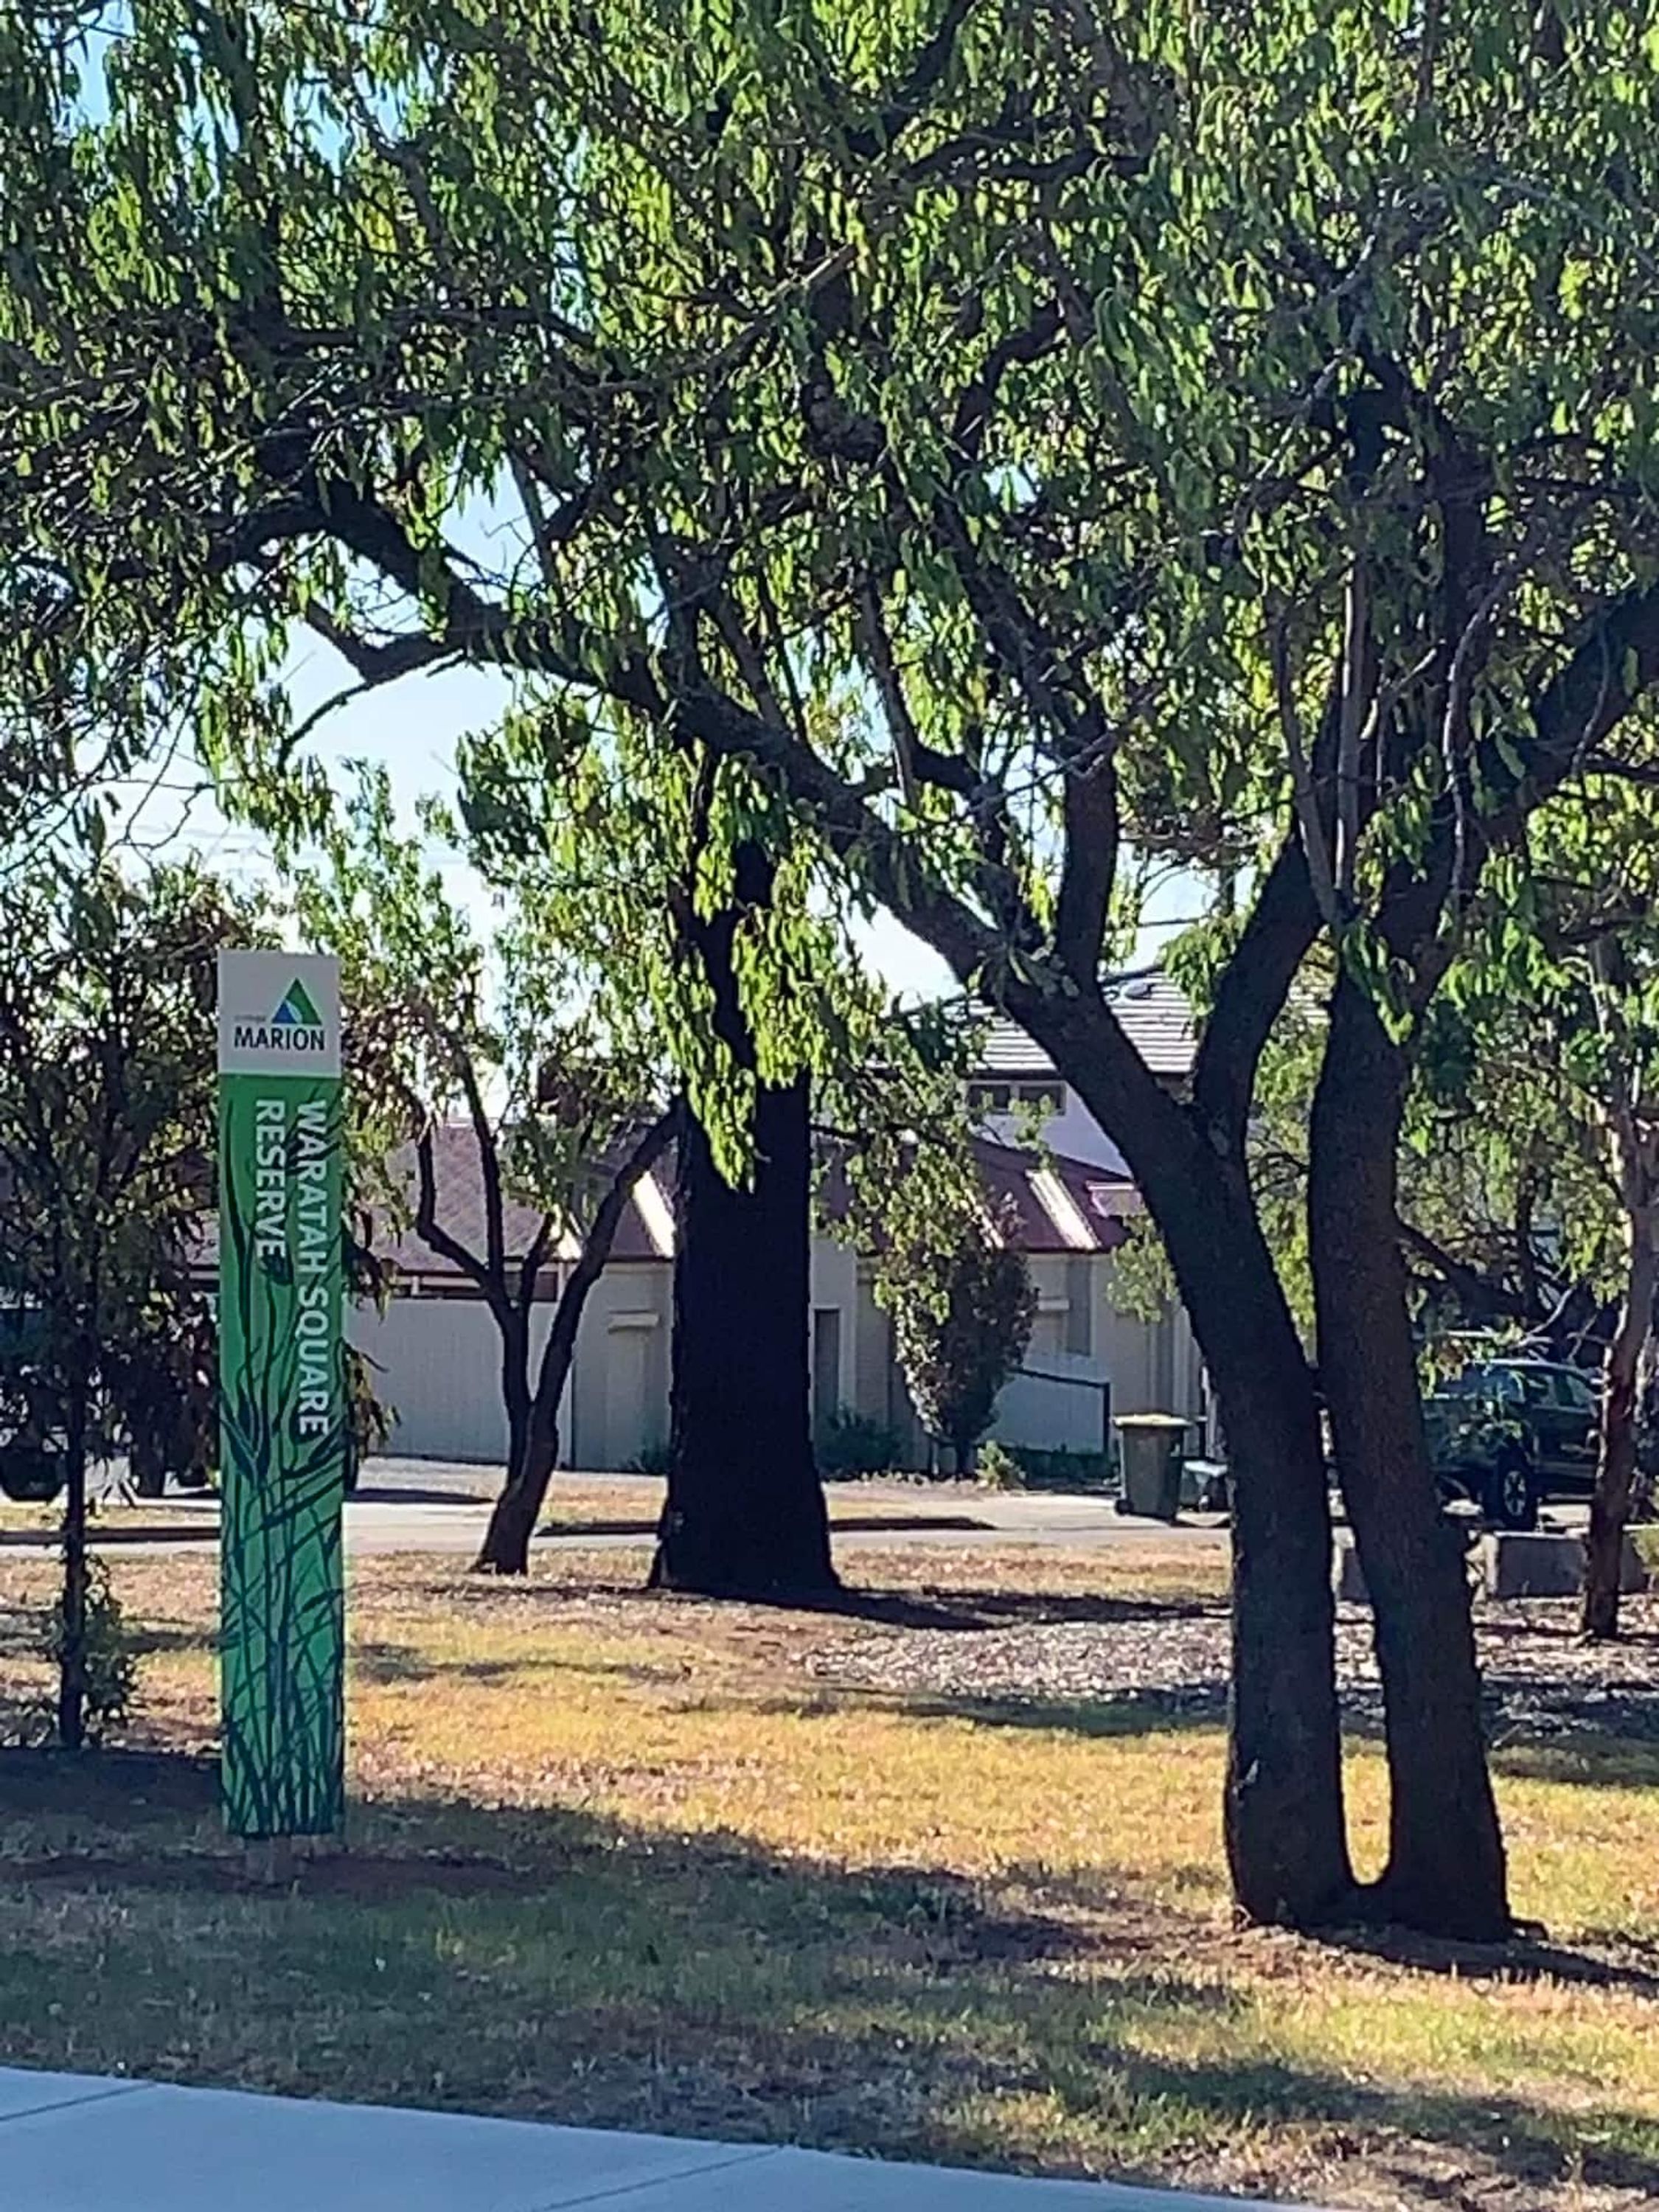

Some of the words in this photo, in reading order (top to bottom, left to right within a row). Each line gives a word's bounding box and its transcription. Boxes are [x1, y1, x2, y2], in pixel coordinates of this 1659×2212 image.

[234, 1026, 325, 1051] MARION
[255, 1099, 287, 1258] RESERVE
[296, 1100, 327, 1275] WARATAH
[296, 1286, 330, 1436] SQUARE
